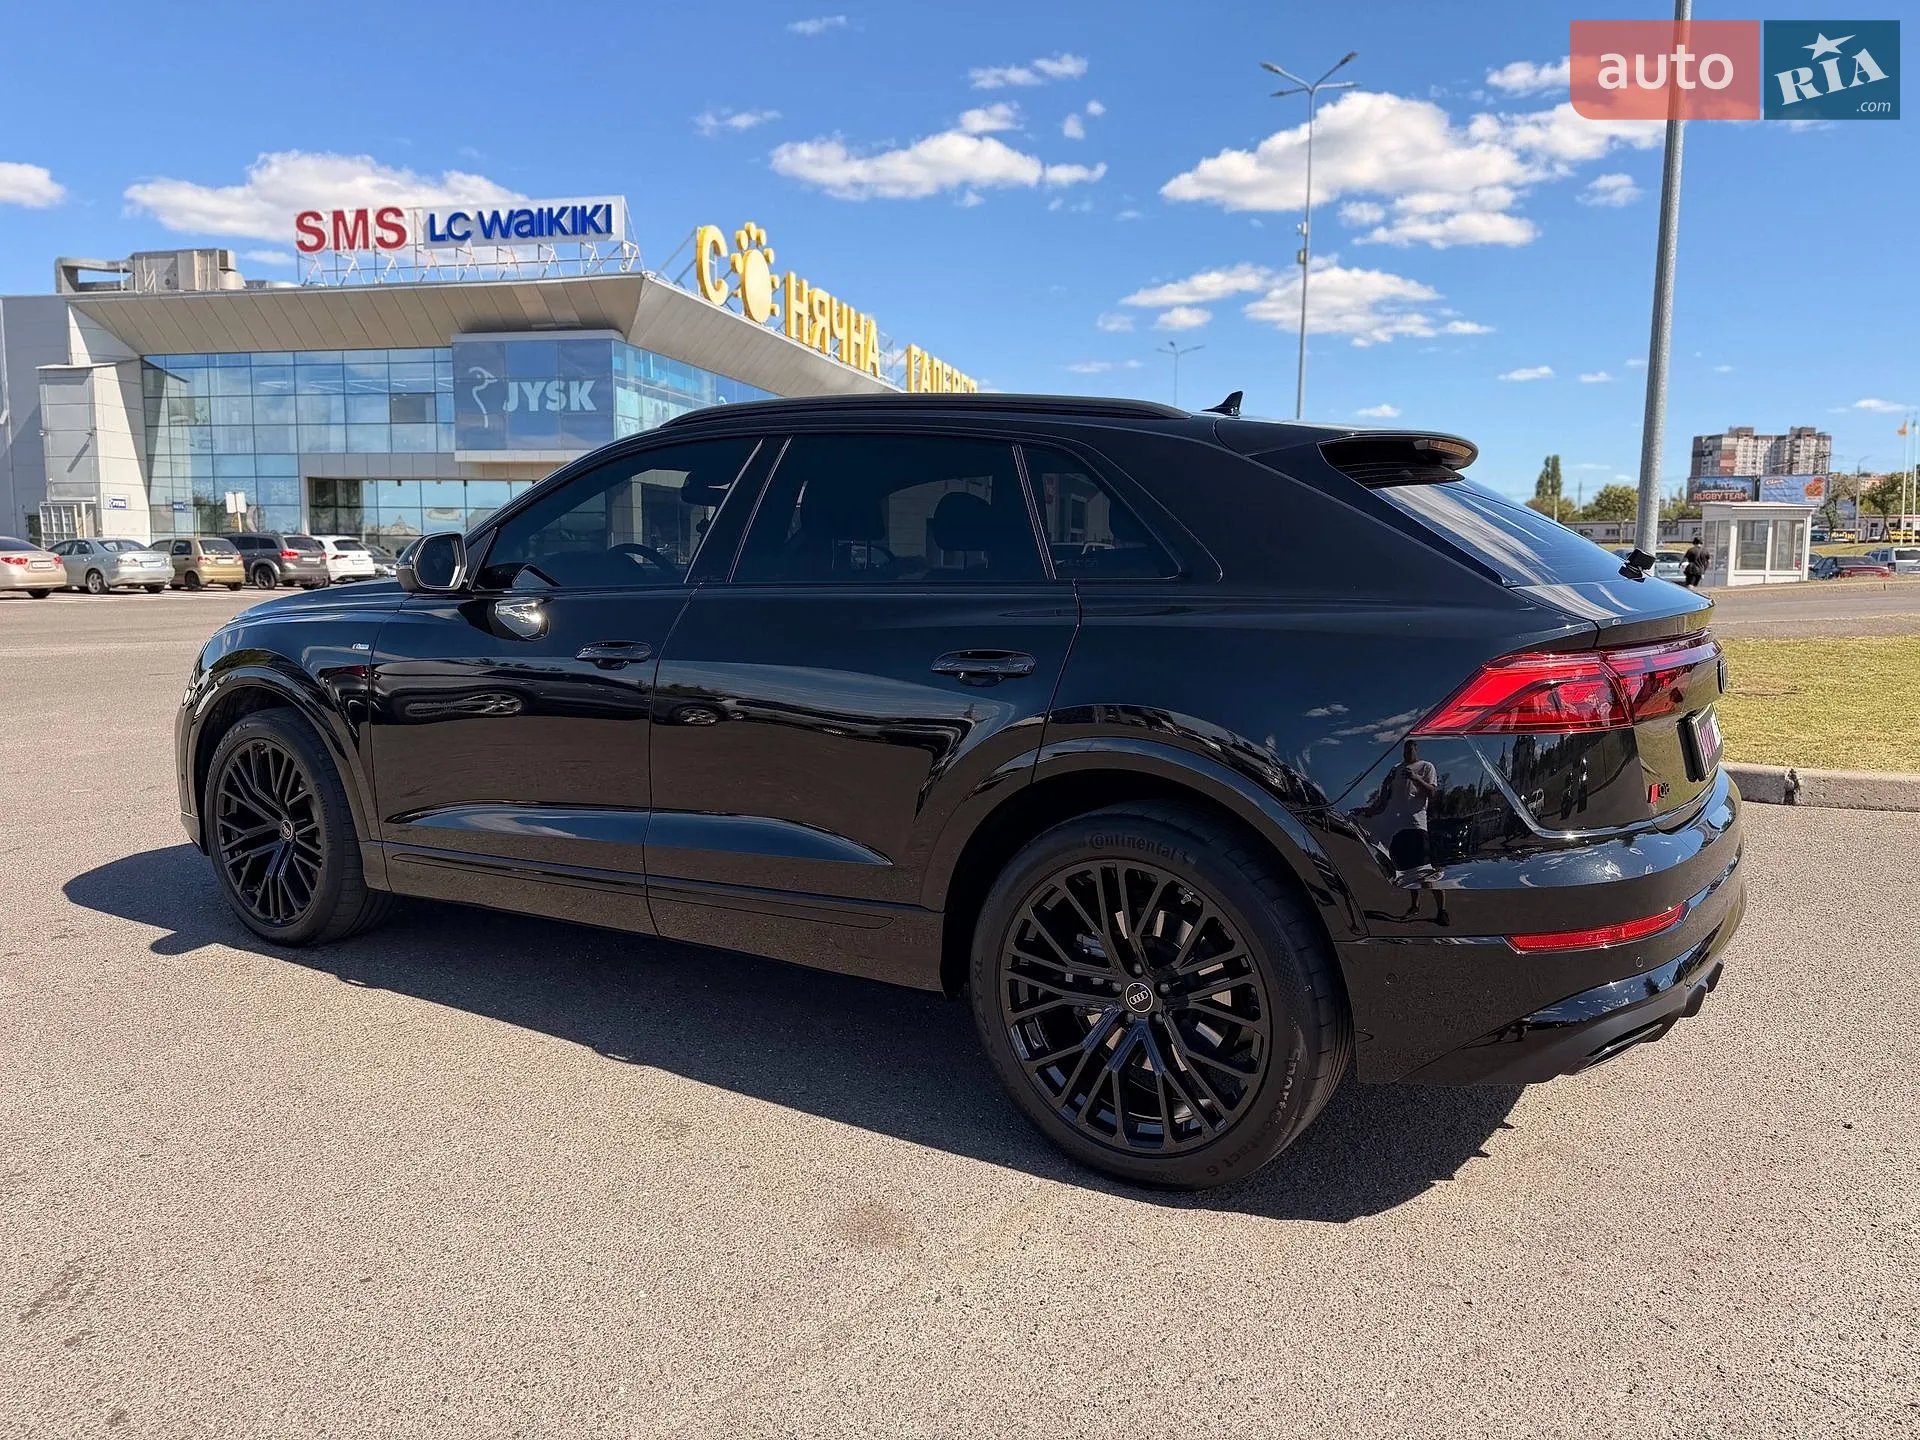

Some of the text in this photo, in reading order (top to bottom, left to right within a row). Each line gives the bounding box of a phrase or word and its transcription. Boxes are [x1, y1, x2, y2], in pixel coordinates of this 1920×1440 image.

[295, 206, 408, 253] SMS
[429, 211, 474, 242] LC
[502, 379, 597, 412] JYSK
[1693, 491, 1749, 501] RUGBY TEAM
[1088, 831, 1177, 861] Continental
